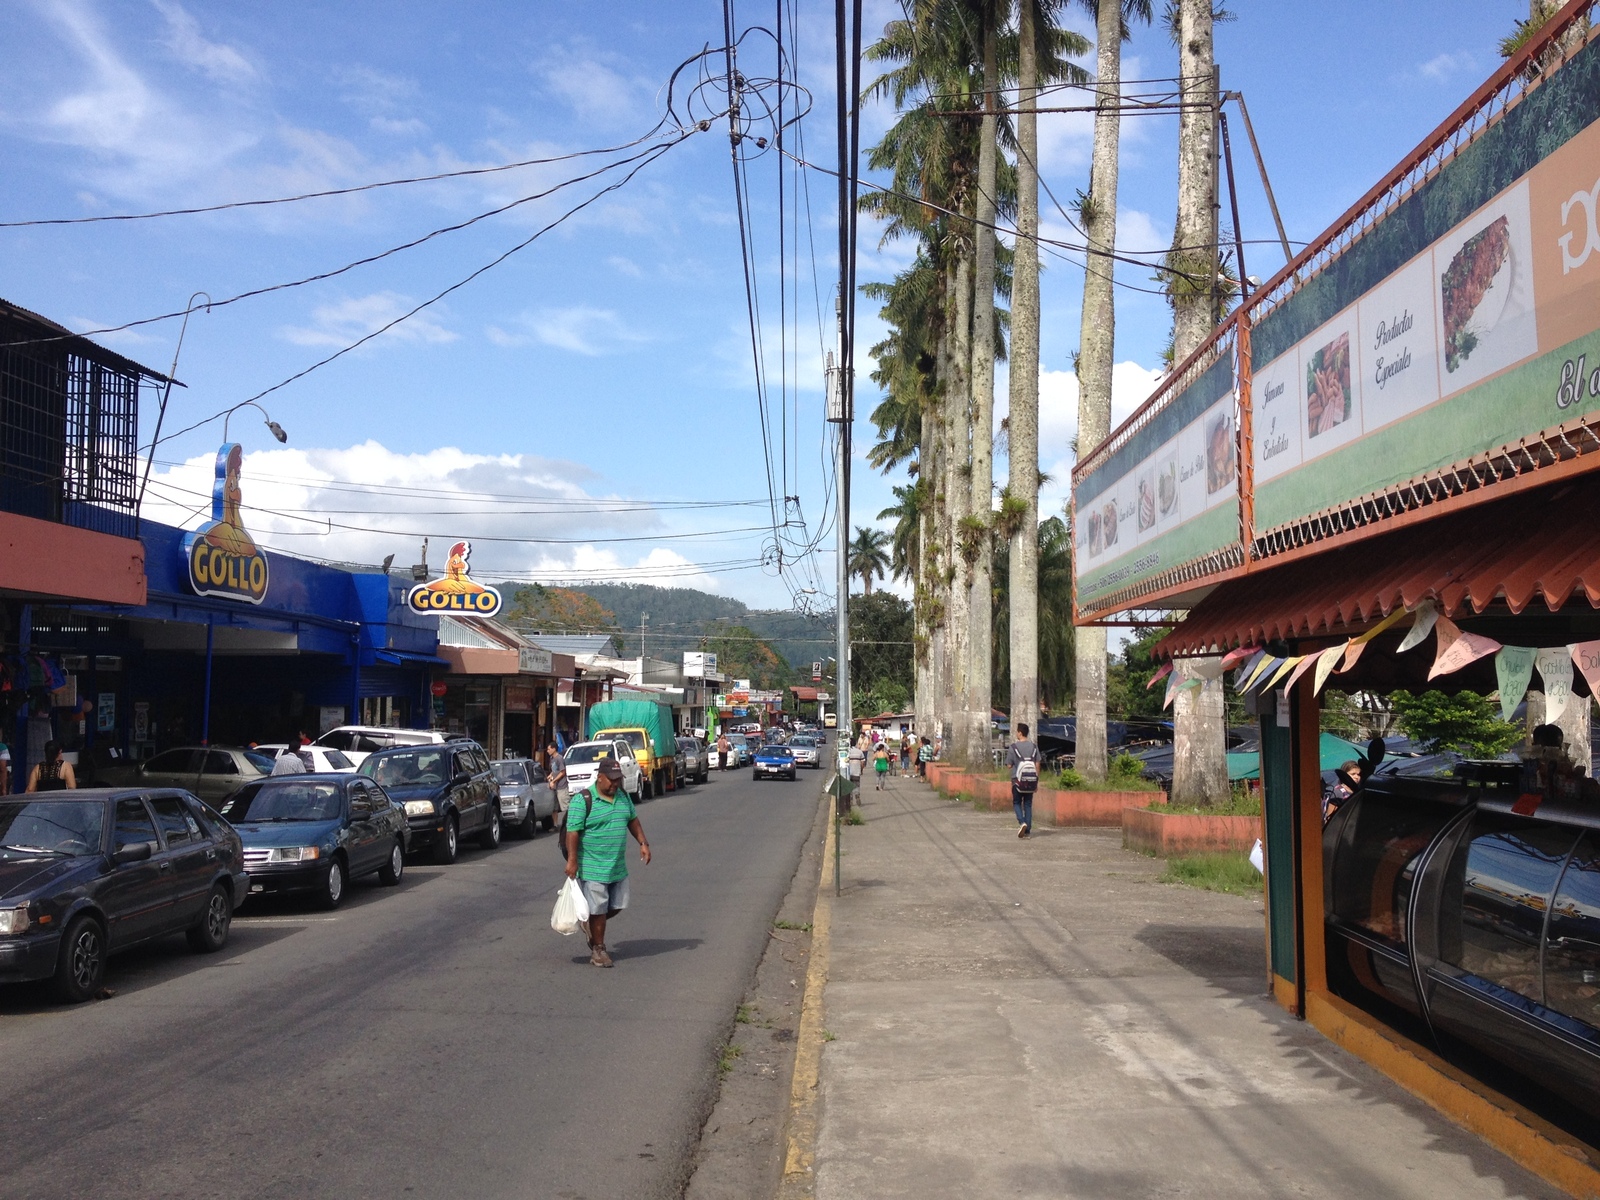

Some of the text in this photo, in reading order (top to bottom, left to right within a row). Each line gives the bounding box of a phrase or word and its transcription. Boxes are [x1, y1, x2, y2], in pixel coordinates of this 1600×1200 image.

[1374, 309, 1413, 351] Productos
[1375, 346, 1412, 390] Especiales
[1556, 353, 1588, 410] El
[193, 543, 266, 593] GOLLO
[413, 588, 497, 611] GOLLO
